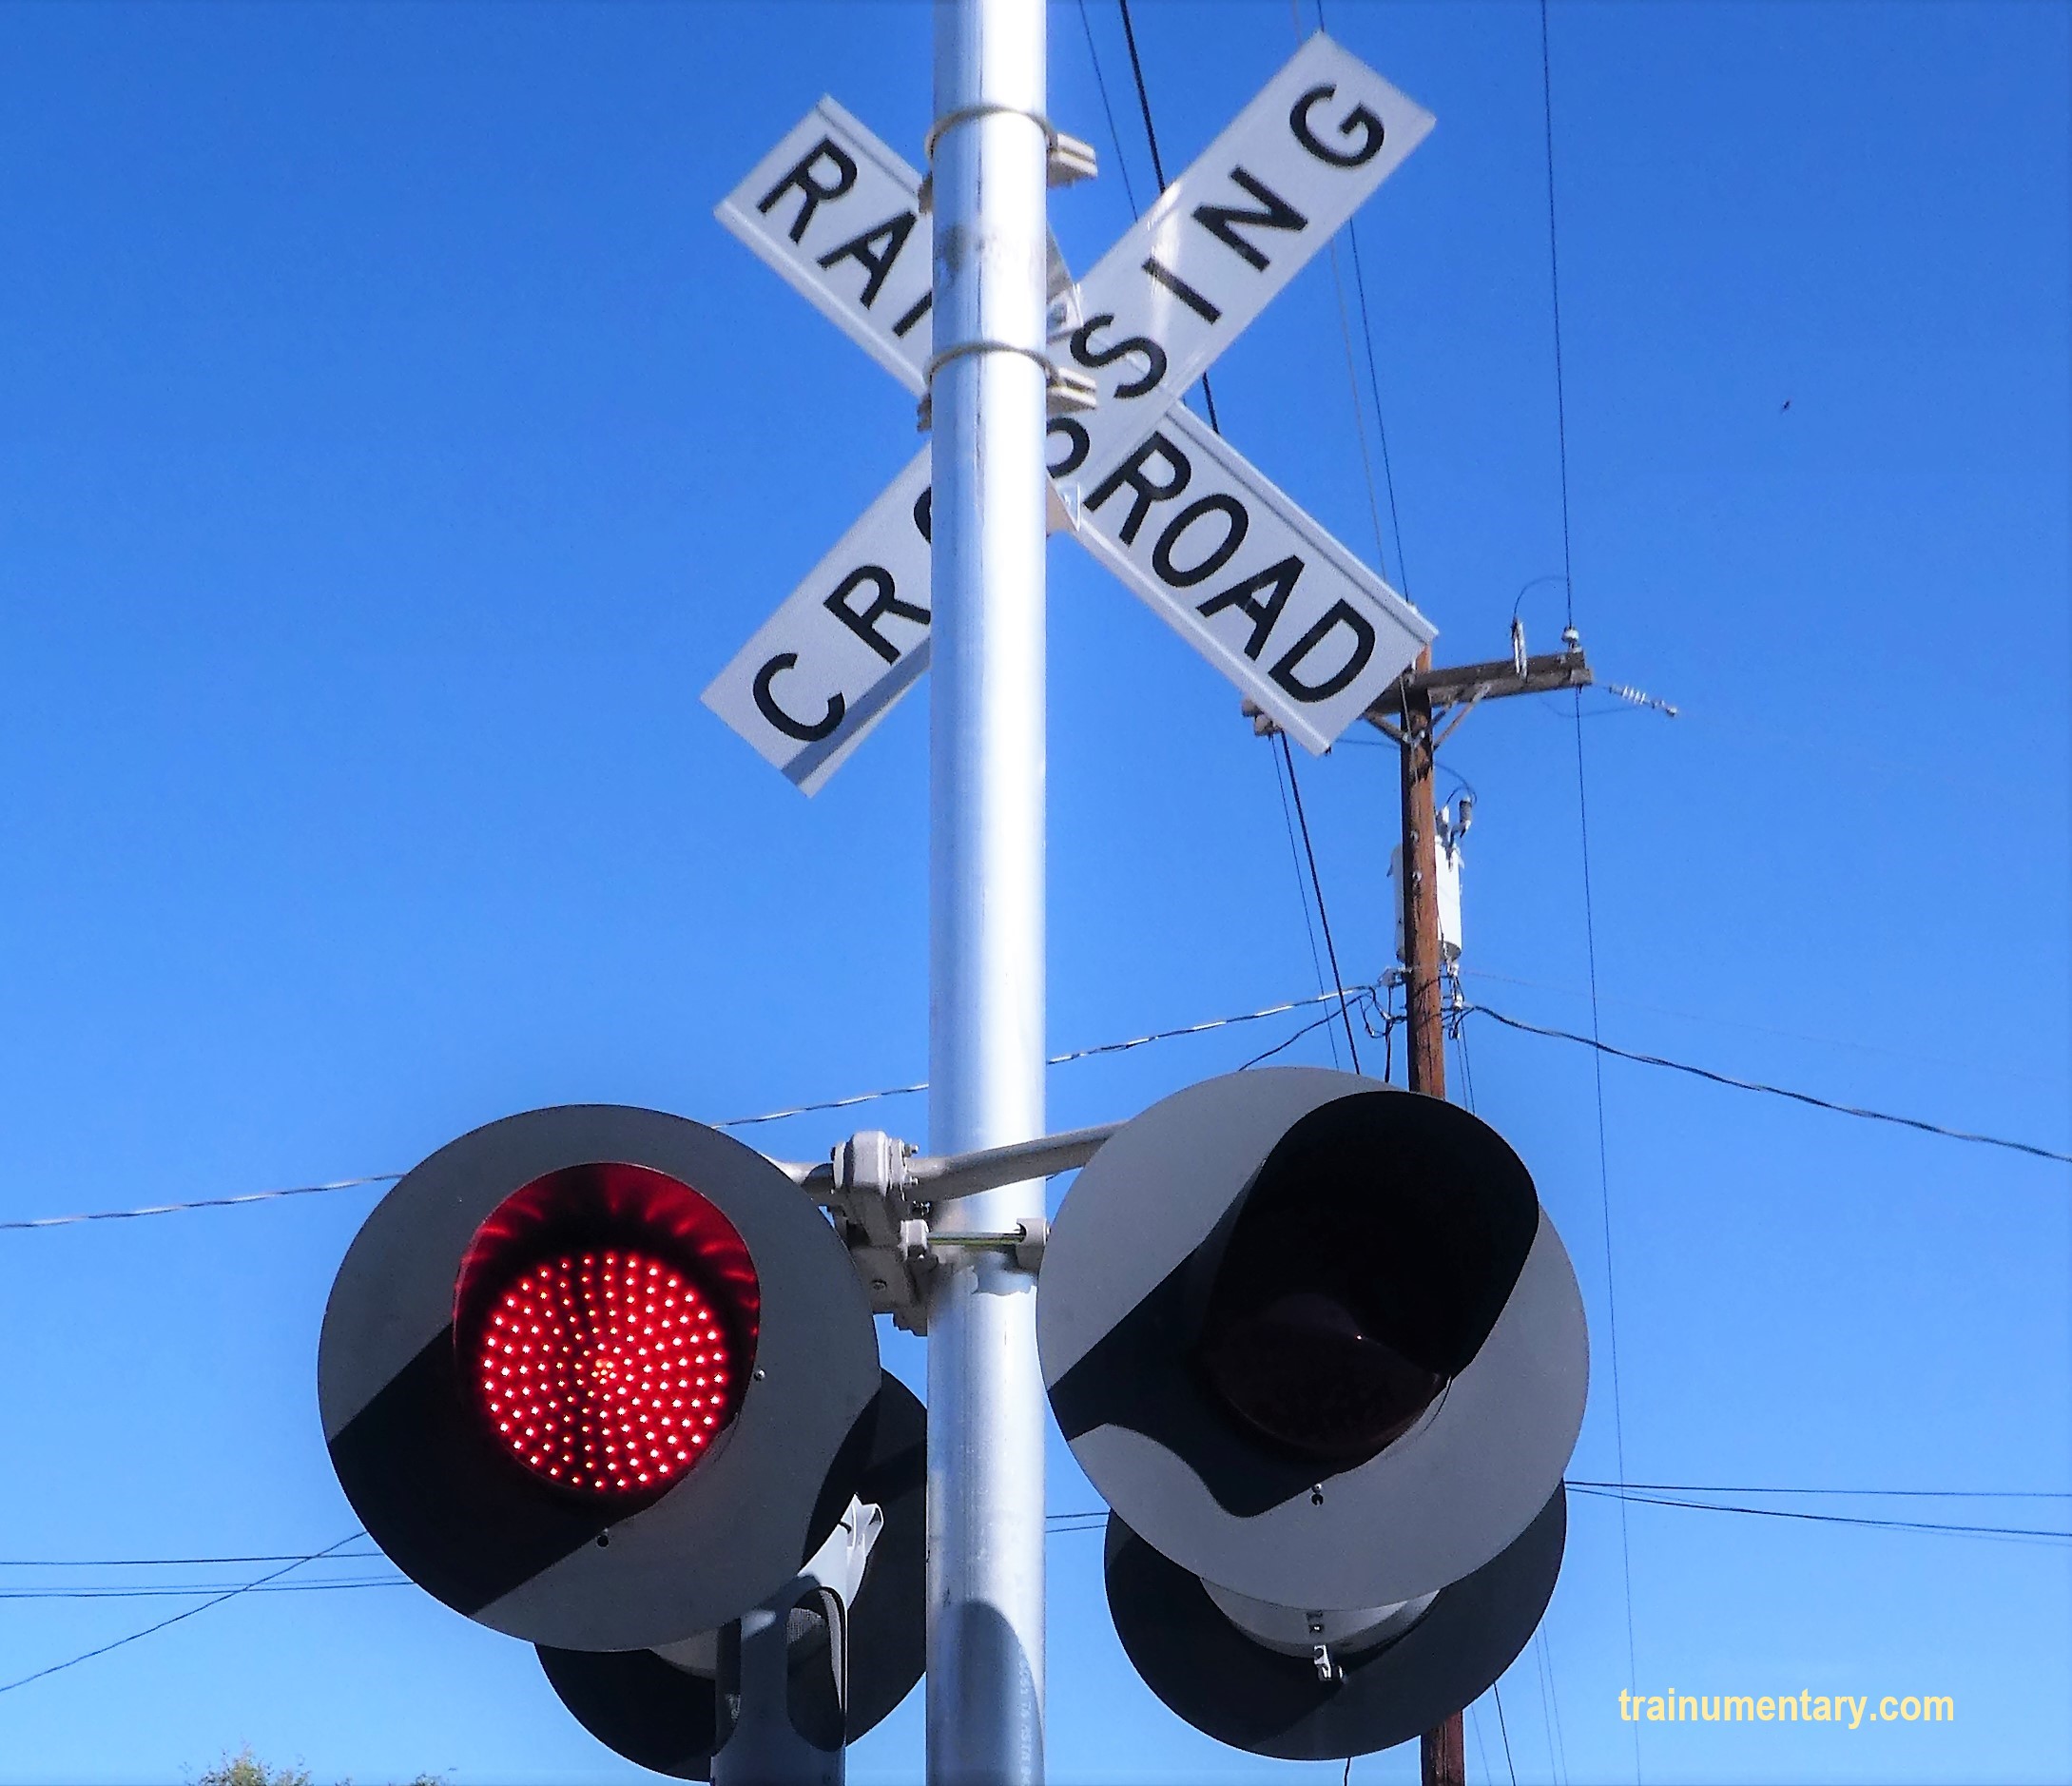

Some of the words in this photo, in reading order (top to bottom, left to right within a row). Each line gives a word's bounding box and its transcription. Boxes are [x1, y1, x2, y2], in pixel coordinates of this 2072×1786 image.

[753, 83, 1385, 742] CRSING
[757, 136, 933, 337] RAI
[1082, 431, 1376, 703] ROAD
